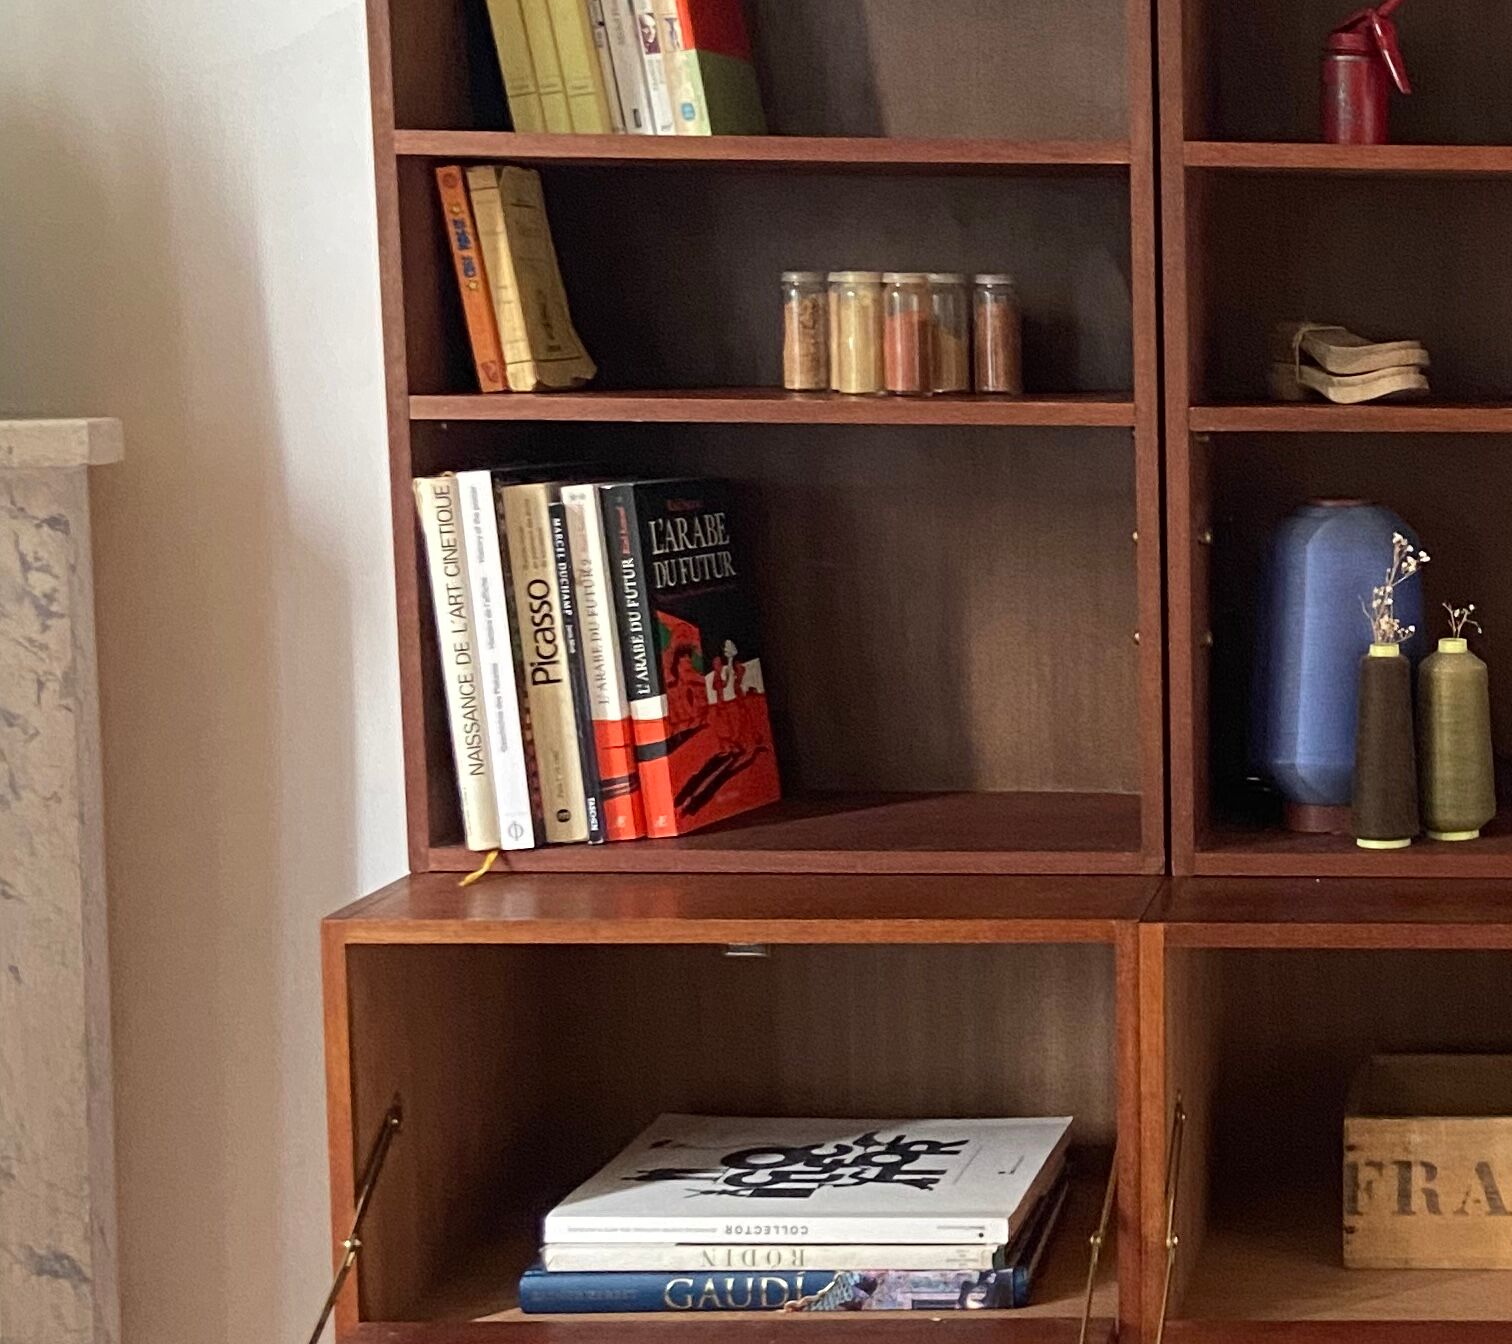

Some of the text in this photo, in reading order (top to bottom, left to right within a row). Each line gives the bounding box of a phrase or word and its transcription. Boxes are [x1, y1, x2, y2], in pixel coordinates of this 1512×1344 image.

[476, 534, 486, 563] History
[552, 517, 567, 562] MARCEL
[647, 511, 731, 556] L'ARABE
[556, 562, 574, 617] DUCHAMP
[621, 557, 640, 608] FUTUR
[652, 550, 737, 589] DU FUTUR
[582, 567, 598, 618] FUTUR
[433, 484, 485, 776] NAISSANCE DE L'ART CINETIQUE
[527, 578, 563, 686] Picasso
[587, 621, 600, 642] DU
[628, 610, 642, 632] DU
[590, 644, 610, 704] L'ARABE
[630, 634, 651, 695] L'ARABE
[586, 797, 599, 831] TASCHEN
[724, 1225, 809, 1236] COLLECTOR
